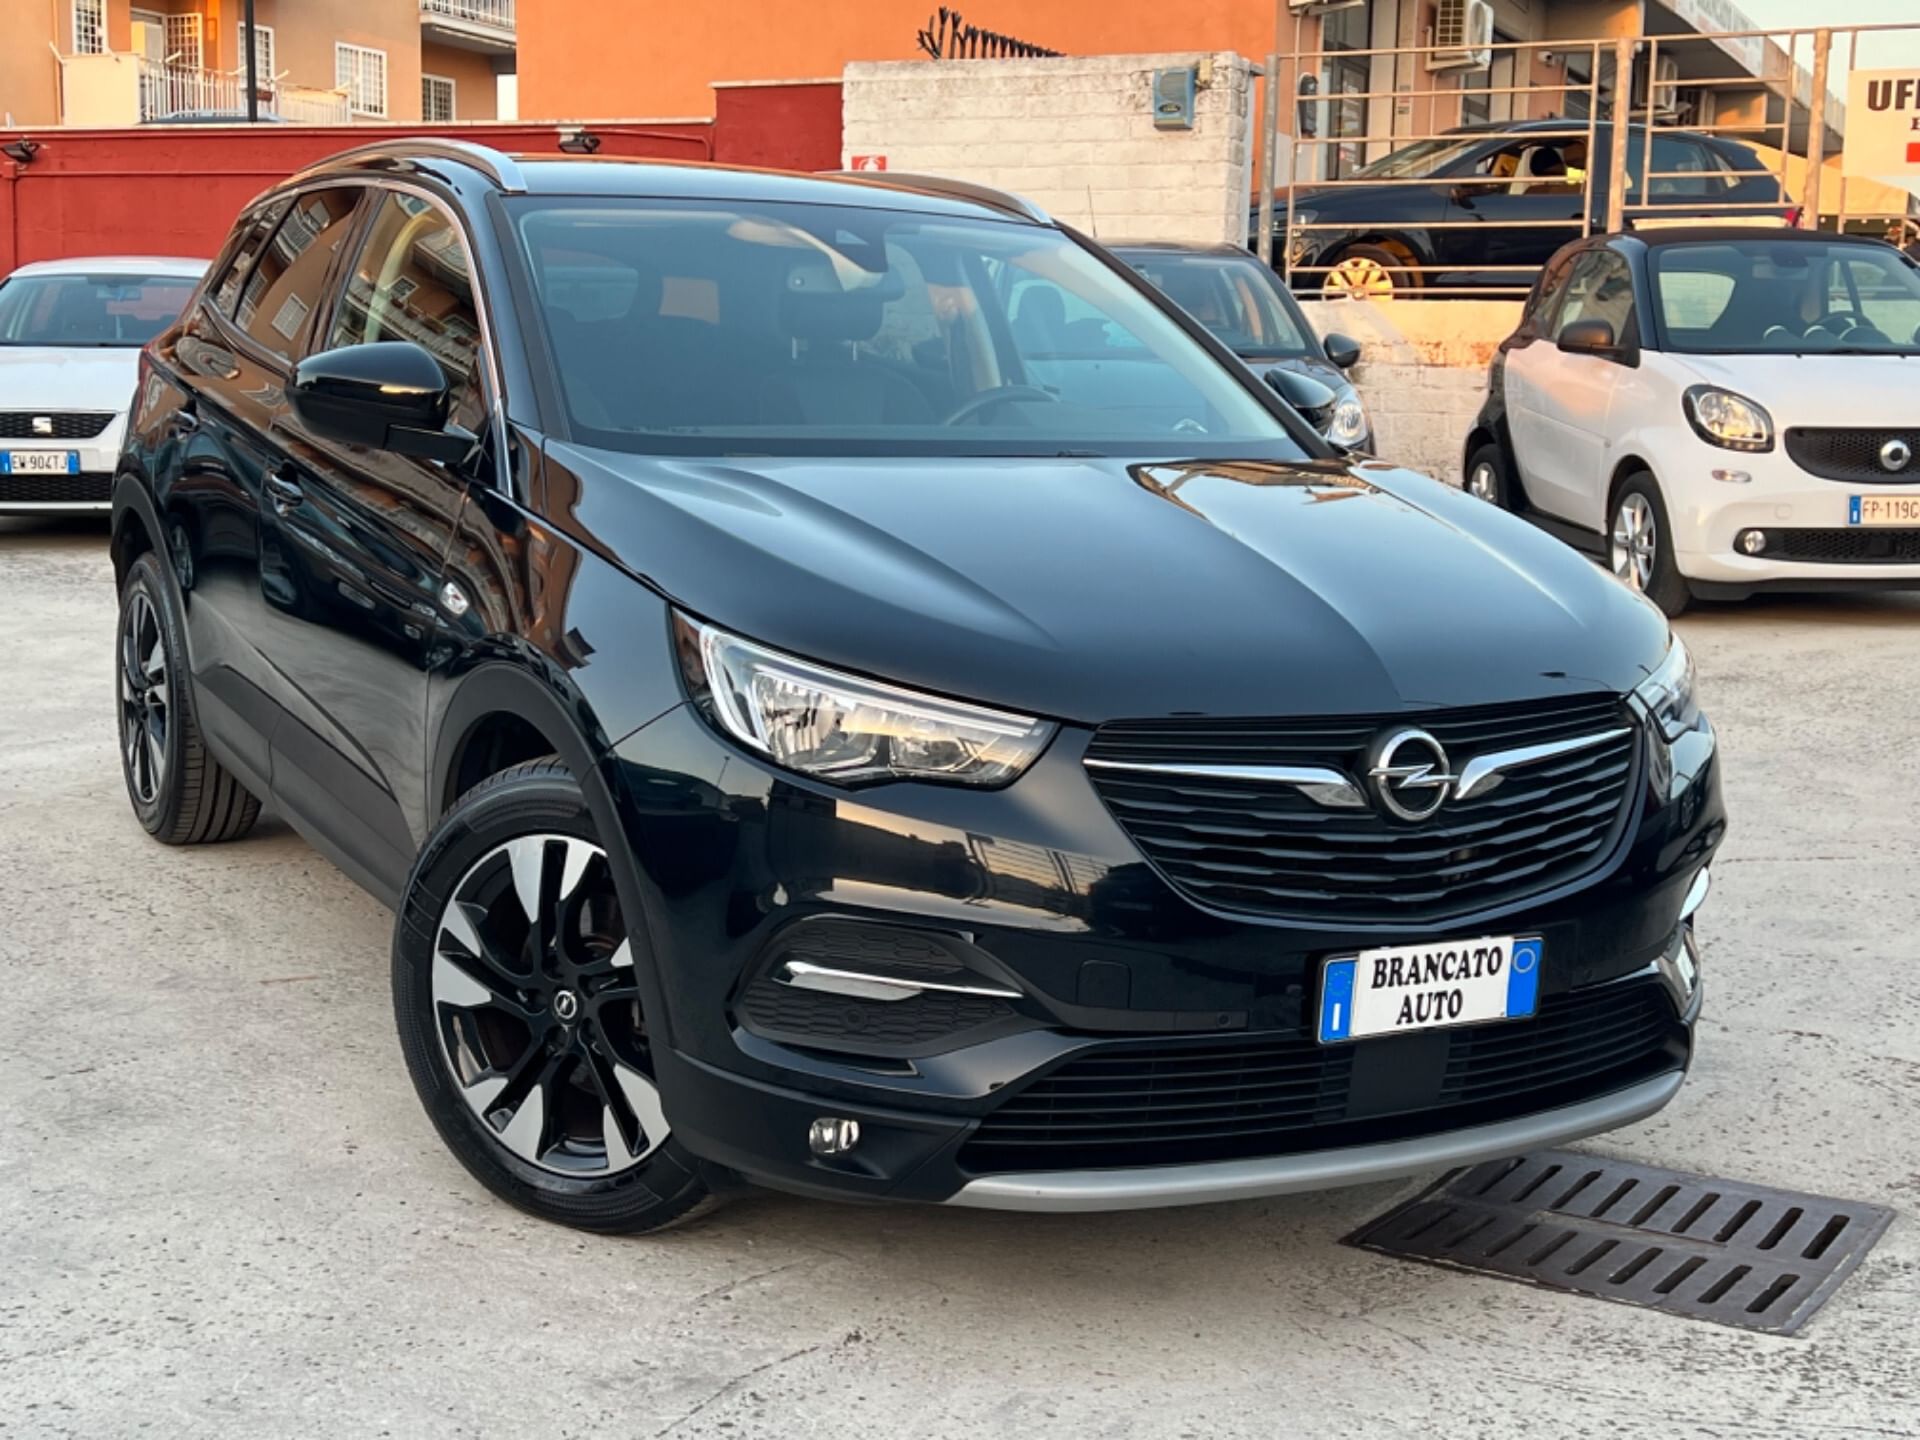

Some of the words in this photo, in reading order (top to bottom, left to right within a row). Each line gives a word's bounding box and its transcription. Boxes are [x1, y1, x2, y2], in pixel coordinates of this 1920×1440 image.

[1868, 79, 1920, 111] UF
[1371, 946, 1503, 989] BRANCATO
[1396, 989, 1463, 1025] AUTO
